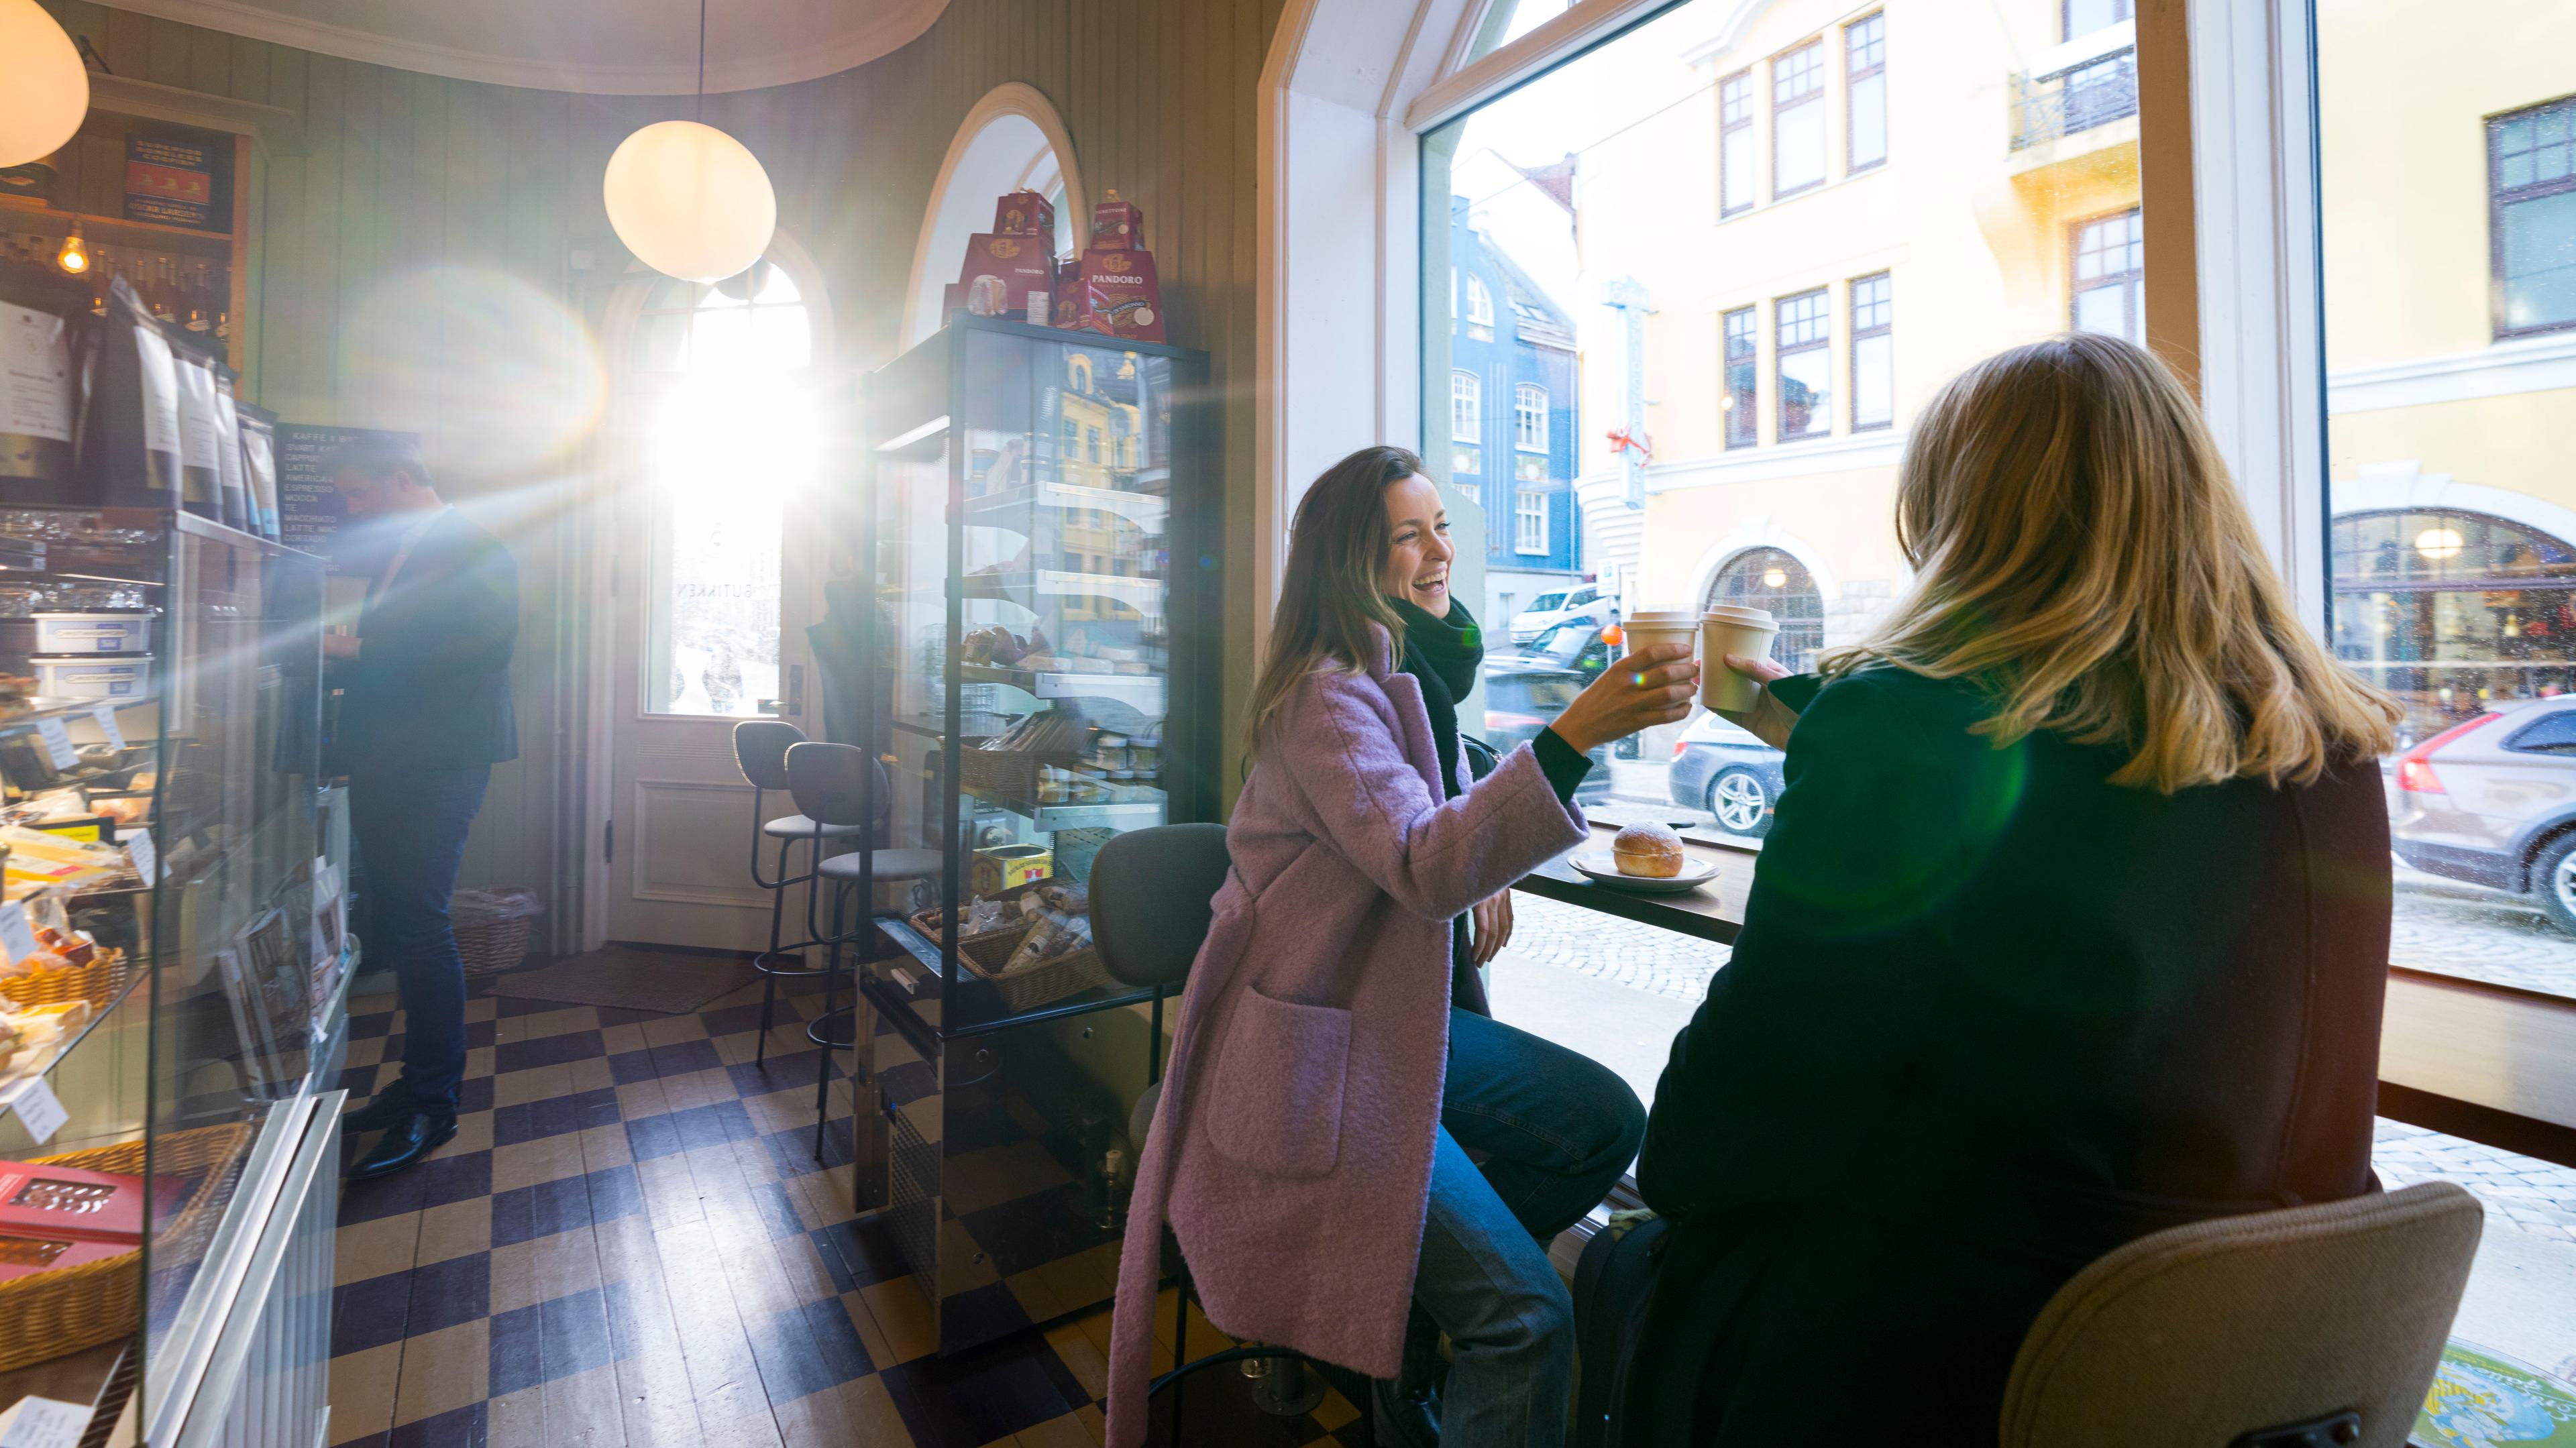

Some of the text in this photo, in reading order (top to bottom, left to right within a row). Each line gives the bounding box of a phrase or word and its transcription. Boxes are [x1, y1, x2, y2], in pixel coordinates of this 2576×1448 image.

[1014, 268, 1044, 276] PANDORO
[1092, 274, 1143, 284] PANDORO
[284, 463, 317, 472] LATTE
[284, 483, 333, 493] ESPRESSO
[284, 494, 318, 502] MOCCA
[284, 504, 297, 512] TE
[284, 514, 337, 523] MACCHIATO
[284, 524, 315, 533] LATTE
